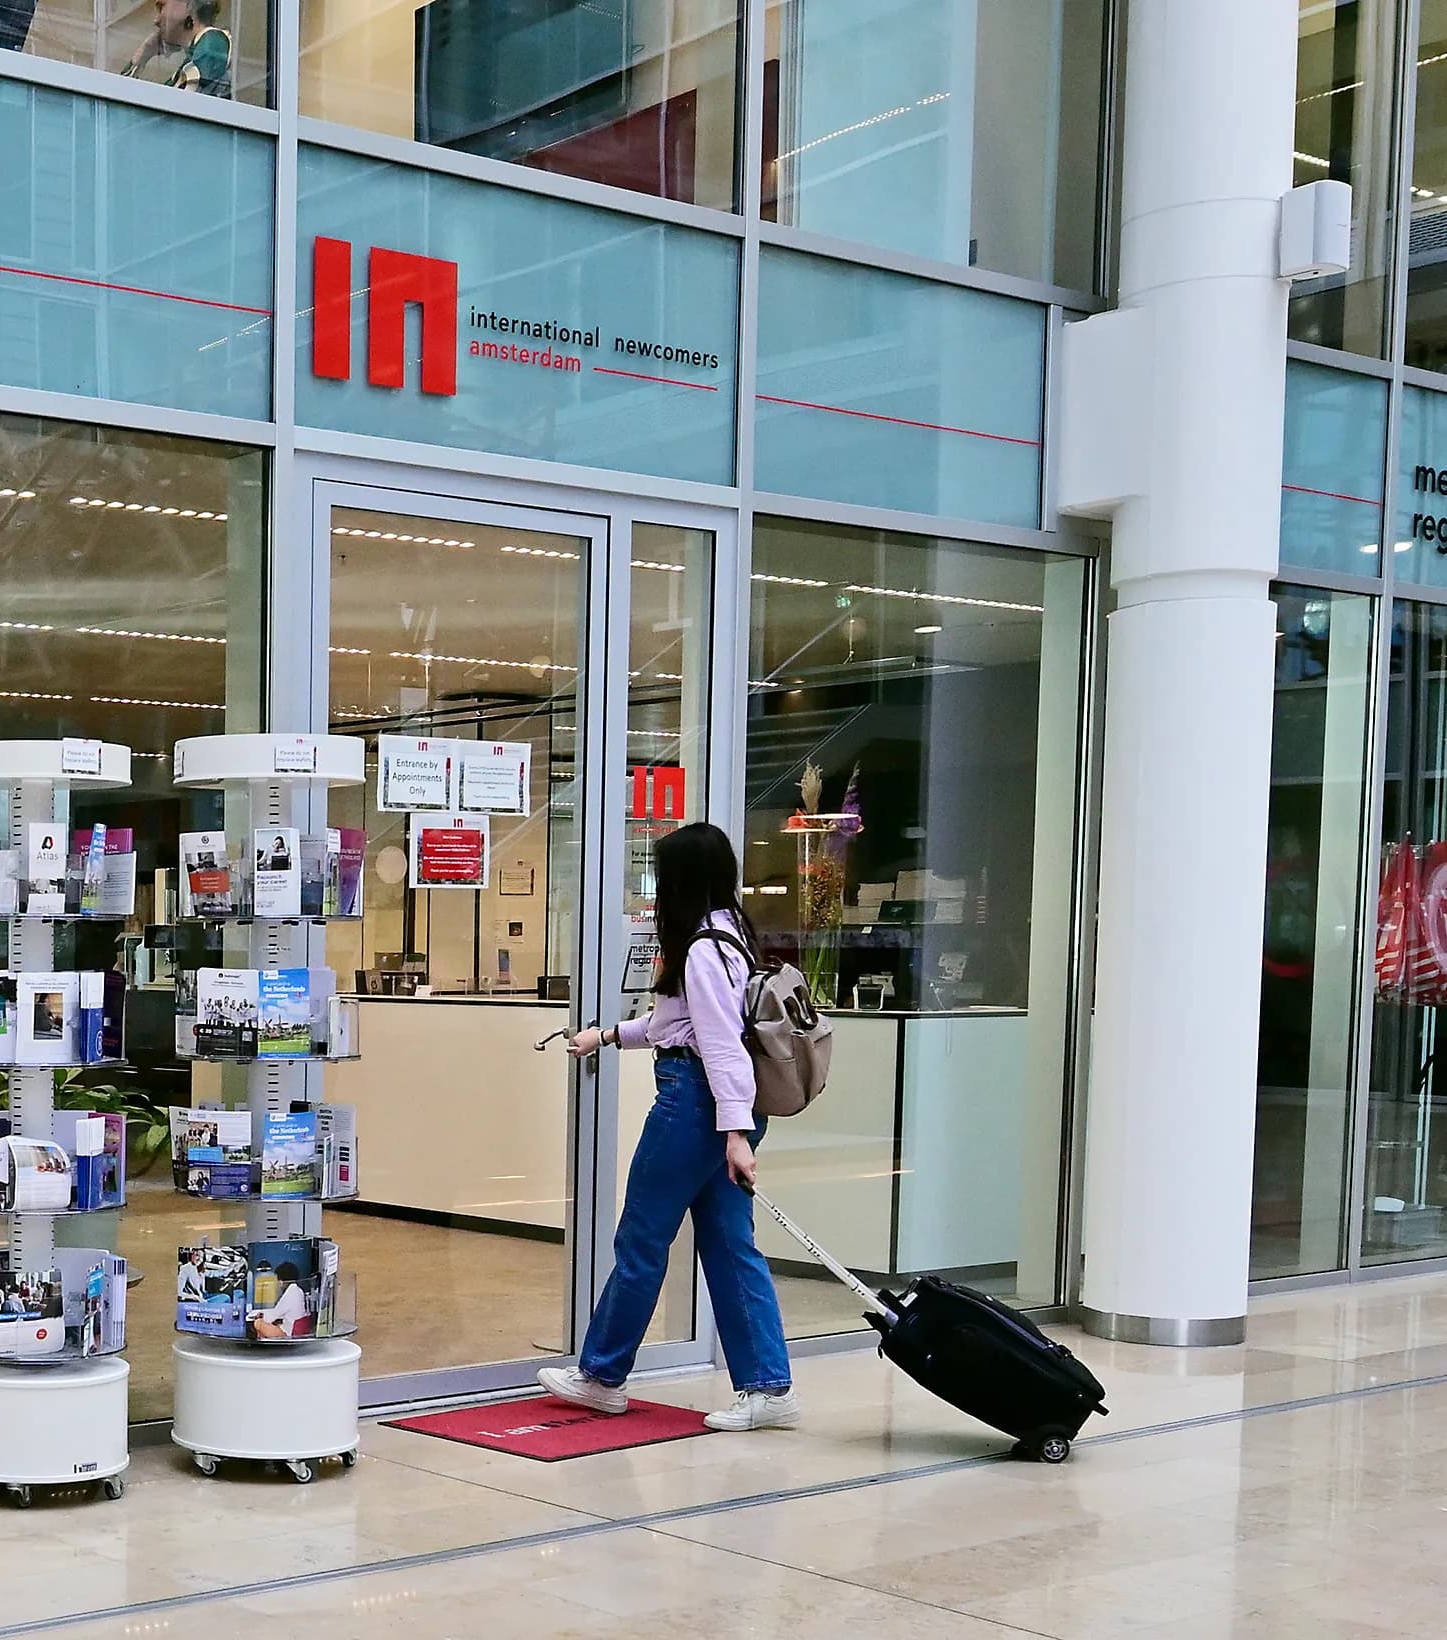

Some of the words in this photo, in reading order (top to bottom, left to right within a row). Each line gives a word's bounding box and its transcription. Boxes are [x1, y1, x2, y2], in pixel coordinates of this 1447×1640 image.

[470, 306, 600, 348] international
[615, 335, 719, 370] newcomers
[468, 339, 582, 372] amsterdam
[396, 758, 427, 769] Entrance
[429, 760, 438, 770] by
[392, 772, 442, 783] Appointments
[409, 786, 426, 797] Only
[36, 851, 59, 861] Atlas
